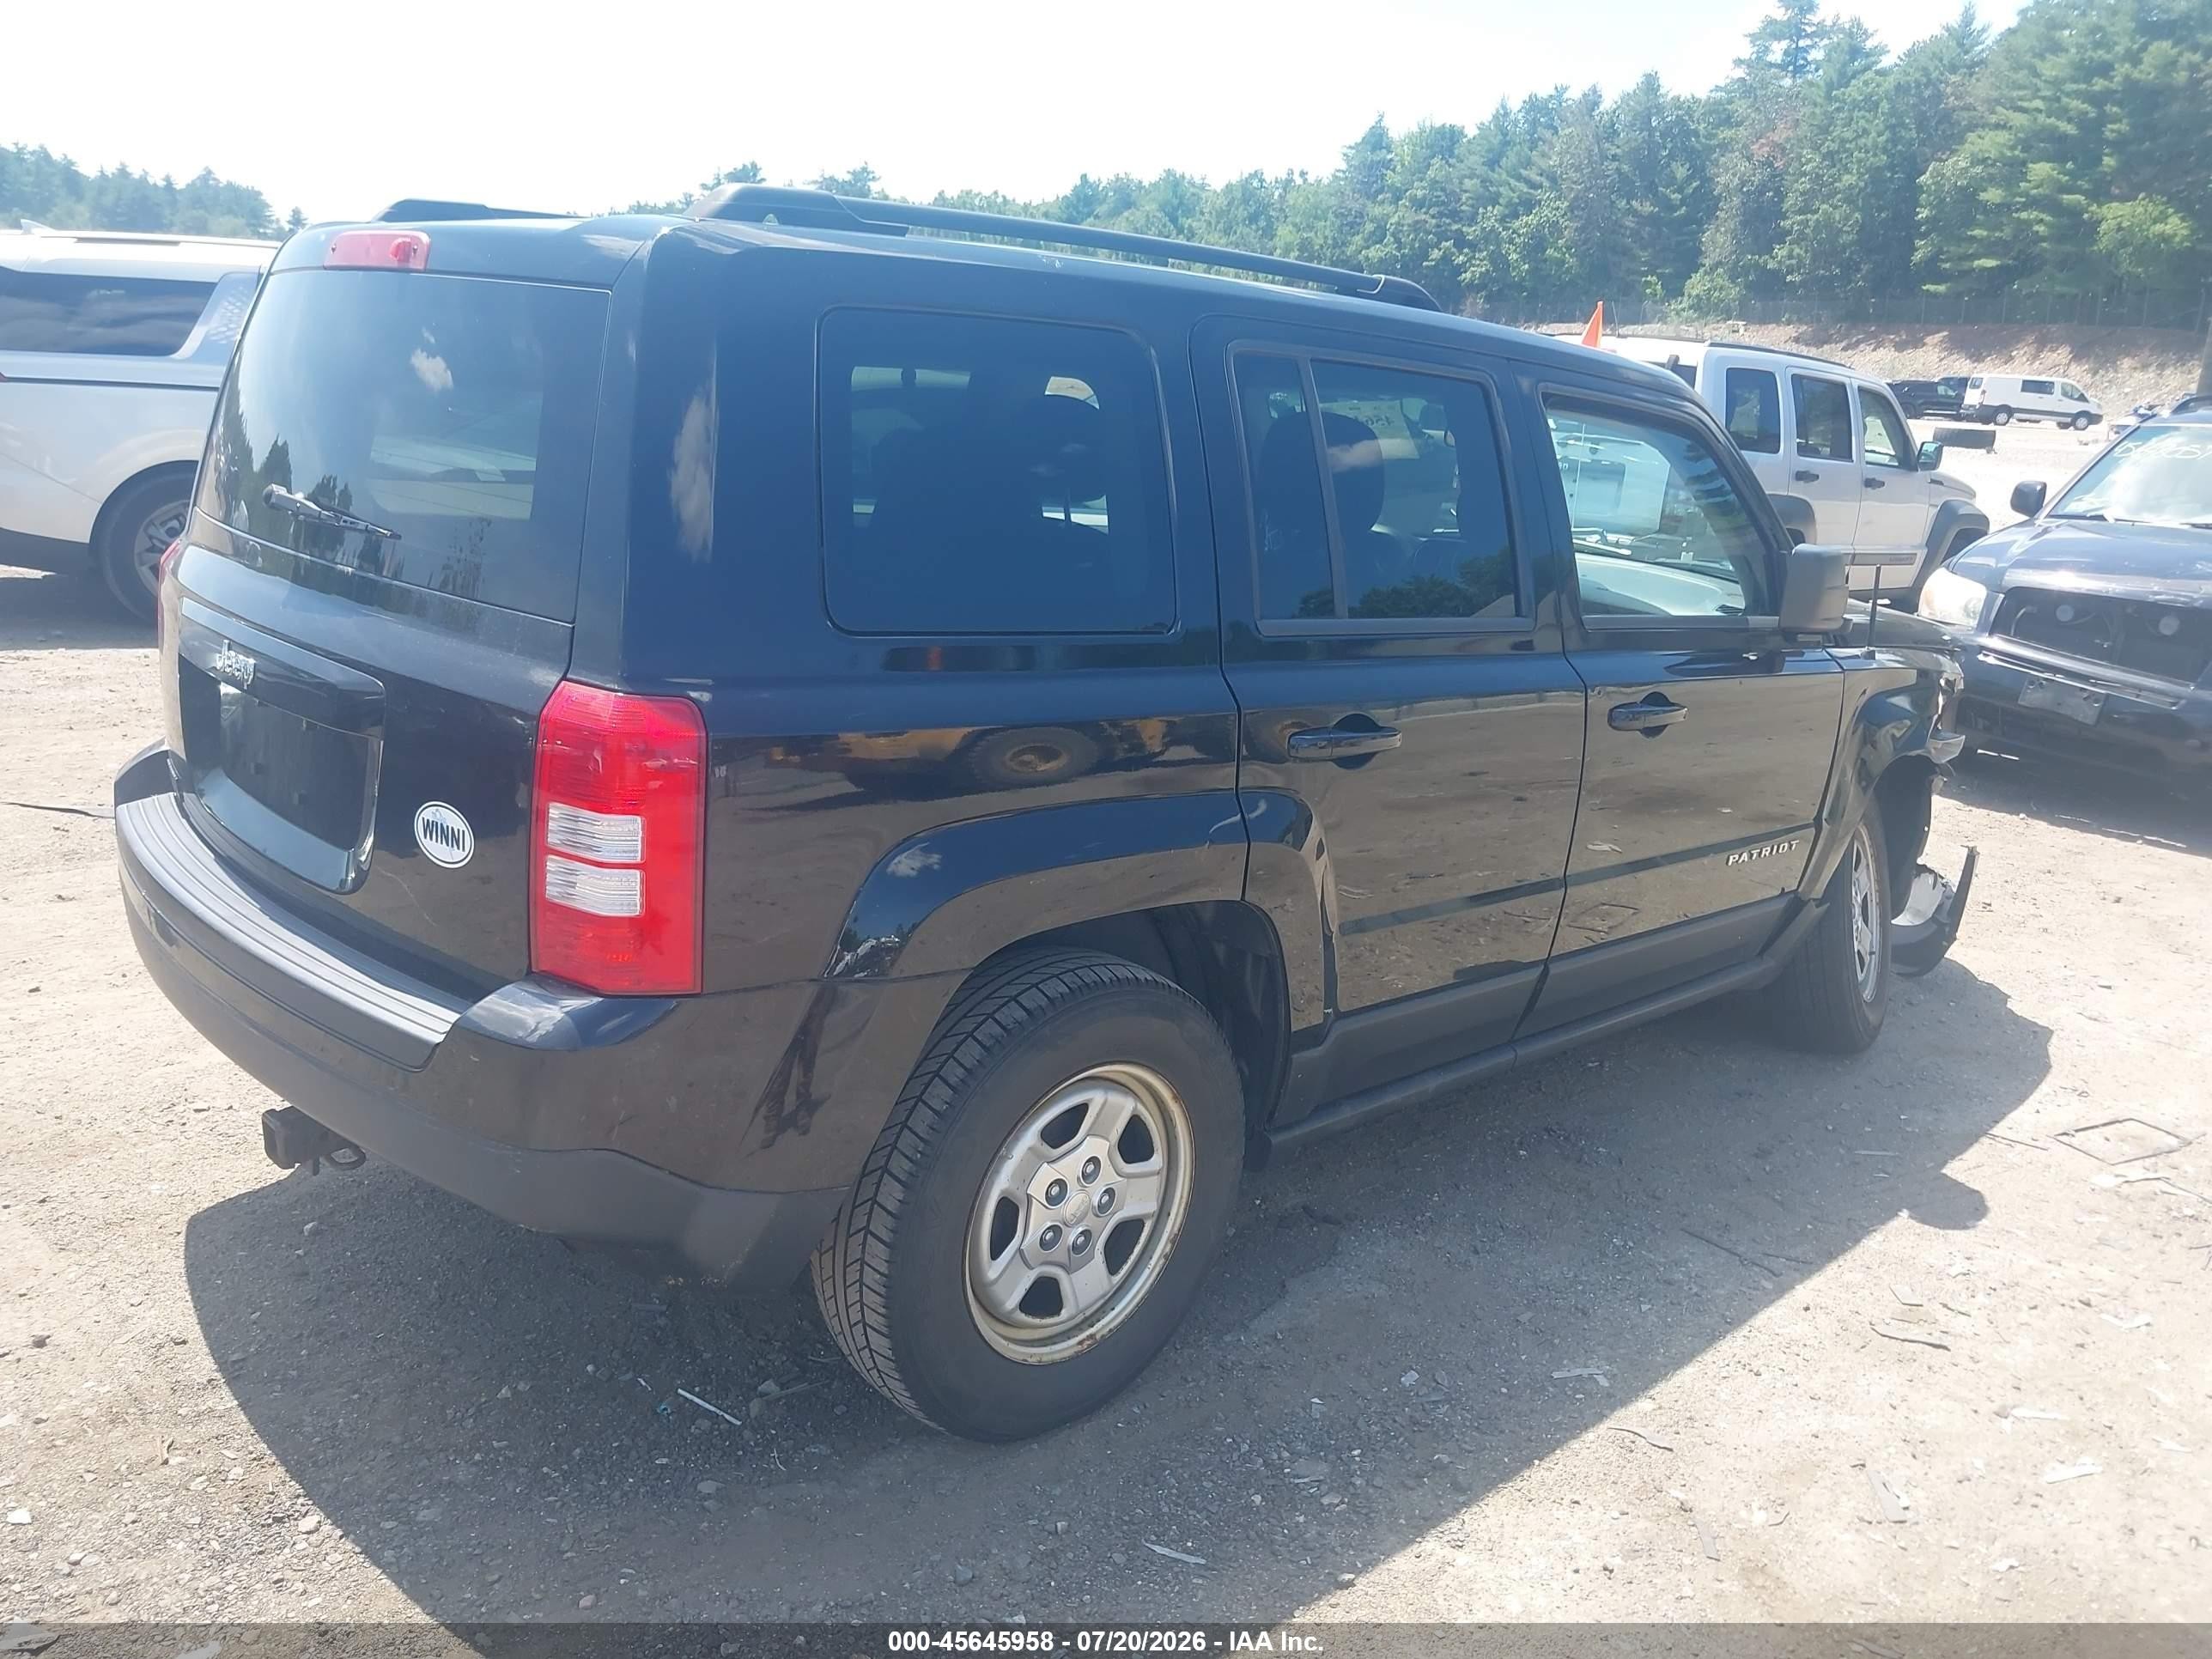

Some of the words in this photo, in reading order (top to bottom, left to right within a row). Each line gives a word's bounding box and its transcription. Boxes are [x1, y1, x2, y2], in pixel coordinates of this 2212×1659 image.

[216, 639, 256, 690] Jeep
[422, 817, 465, 853] WINNI
[1727, 840, 1800, 866] PATRIOT
